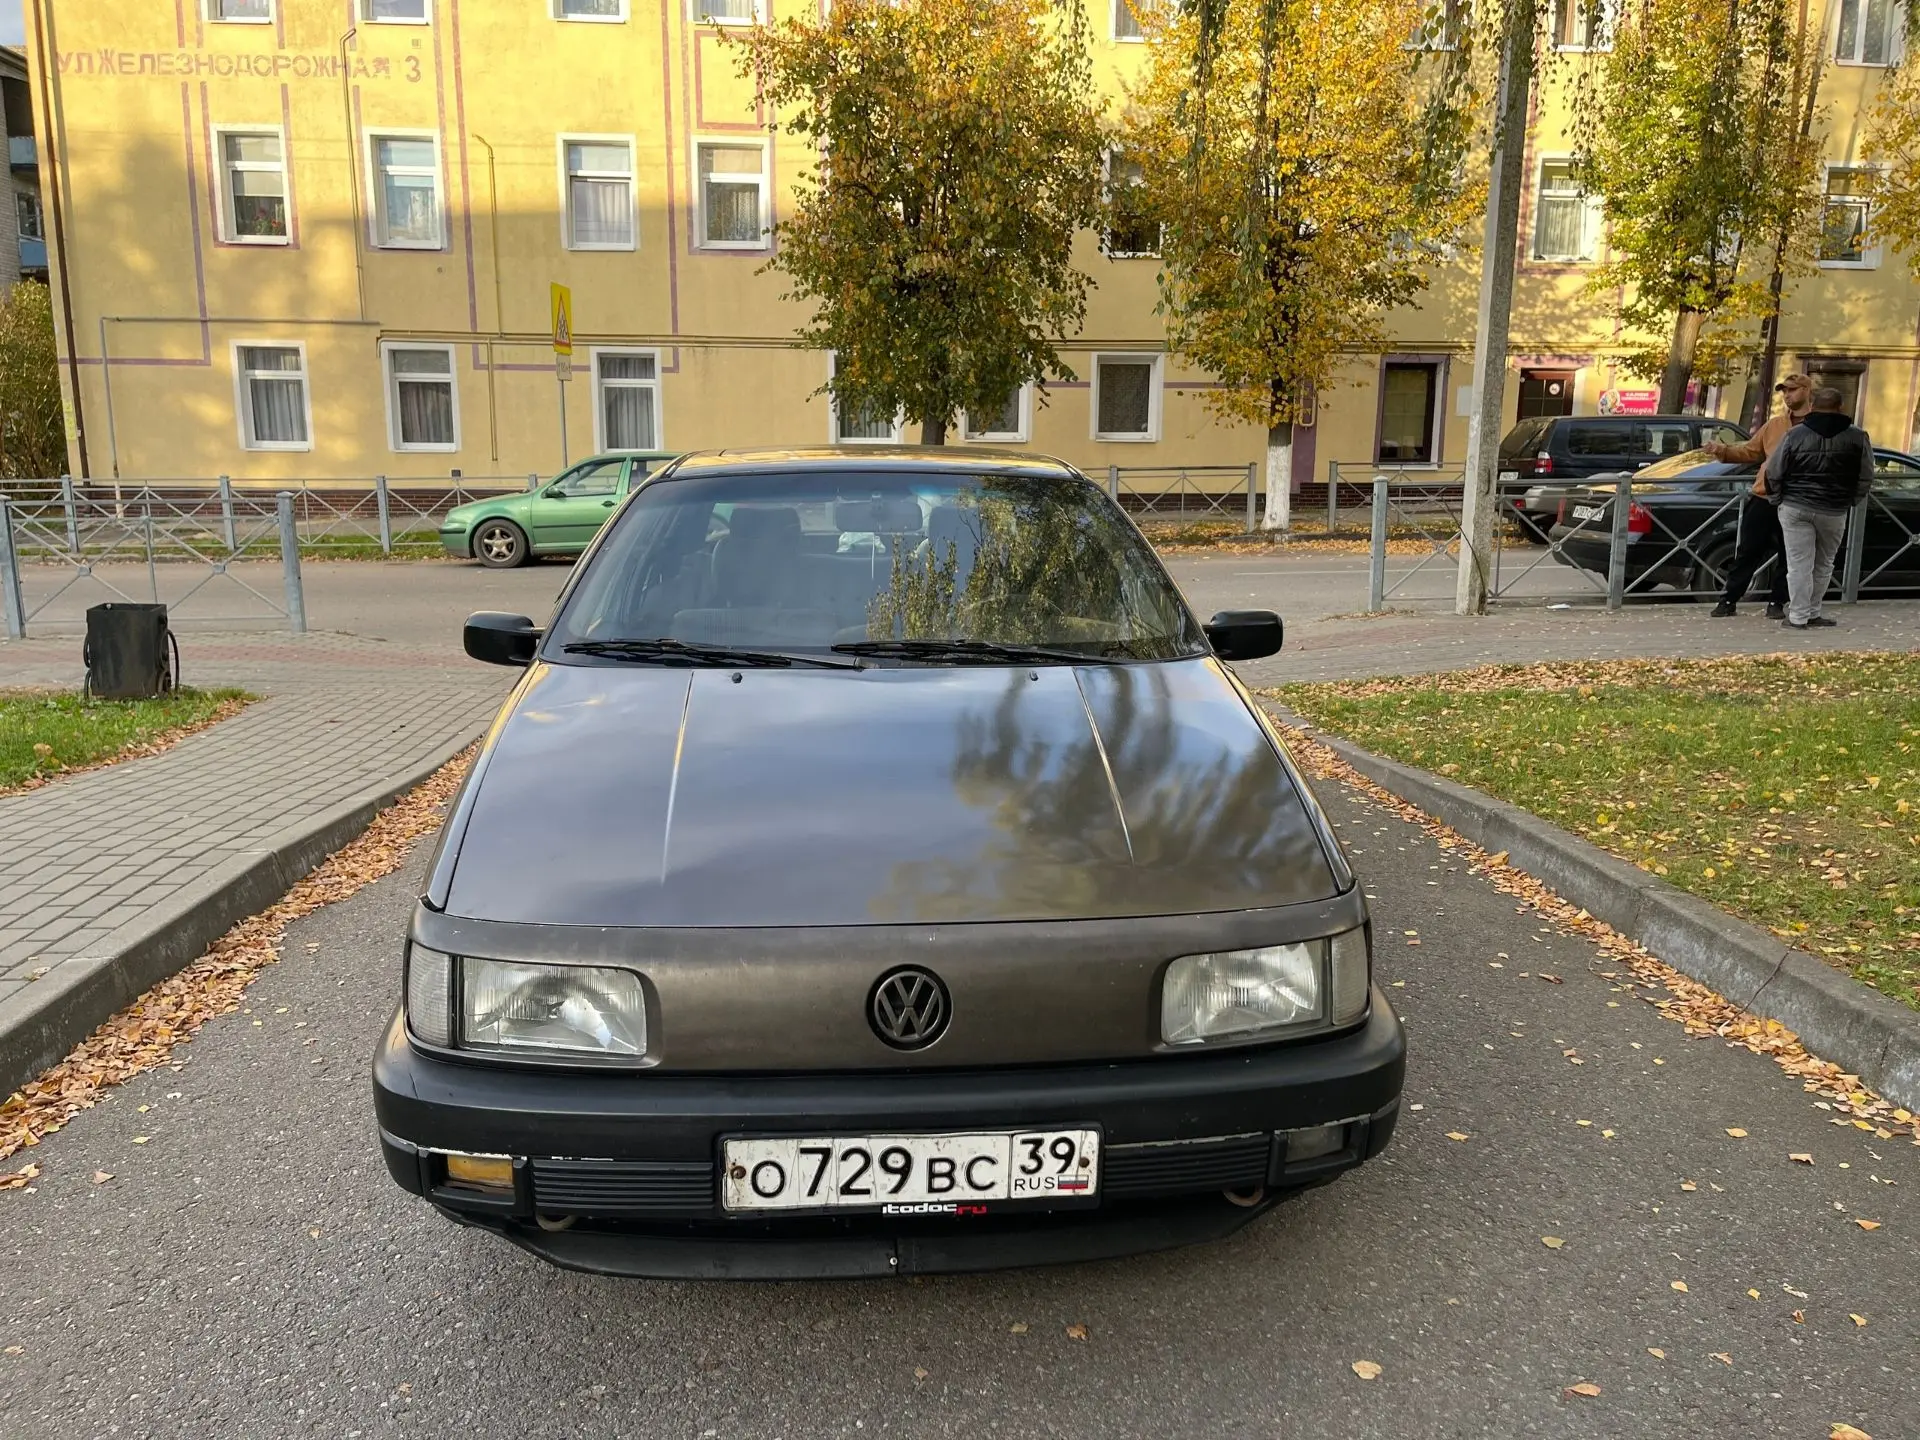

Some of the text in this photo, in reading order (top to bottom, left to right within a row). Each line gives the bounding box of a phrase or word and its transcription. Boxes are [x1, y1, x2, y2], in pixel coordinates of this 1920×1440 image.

[405, 55, 421, 83] 3
[1018, 1135, 1077, 1175] 39
[1013, 1175, 1056, 1192] RUS
